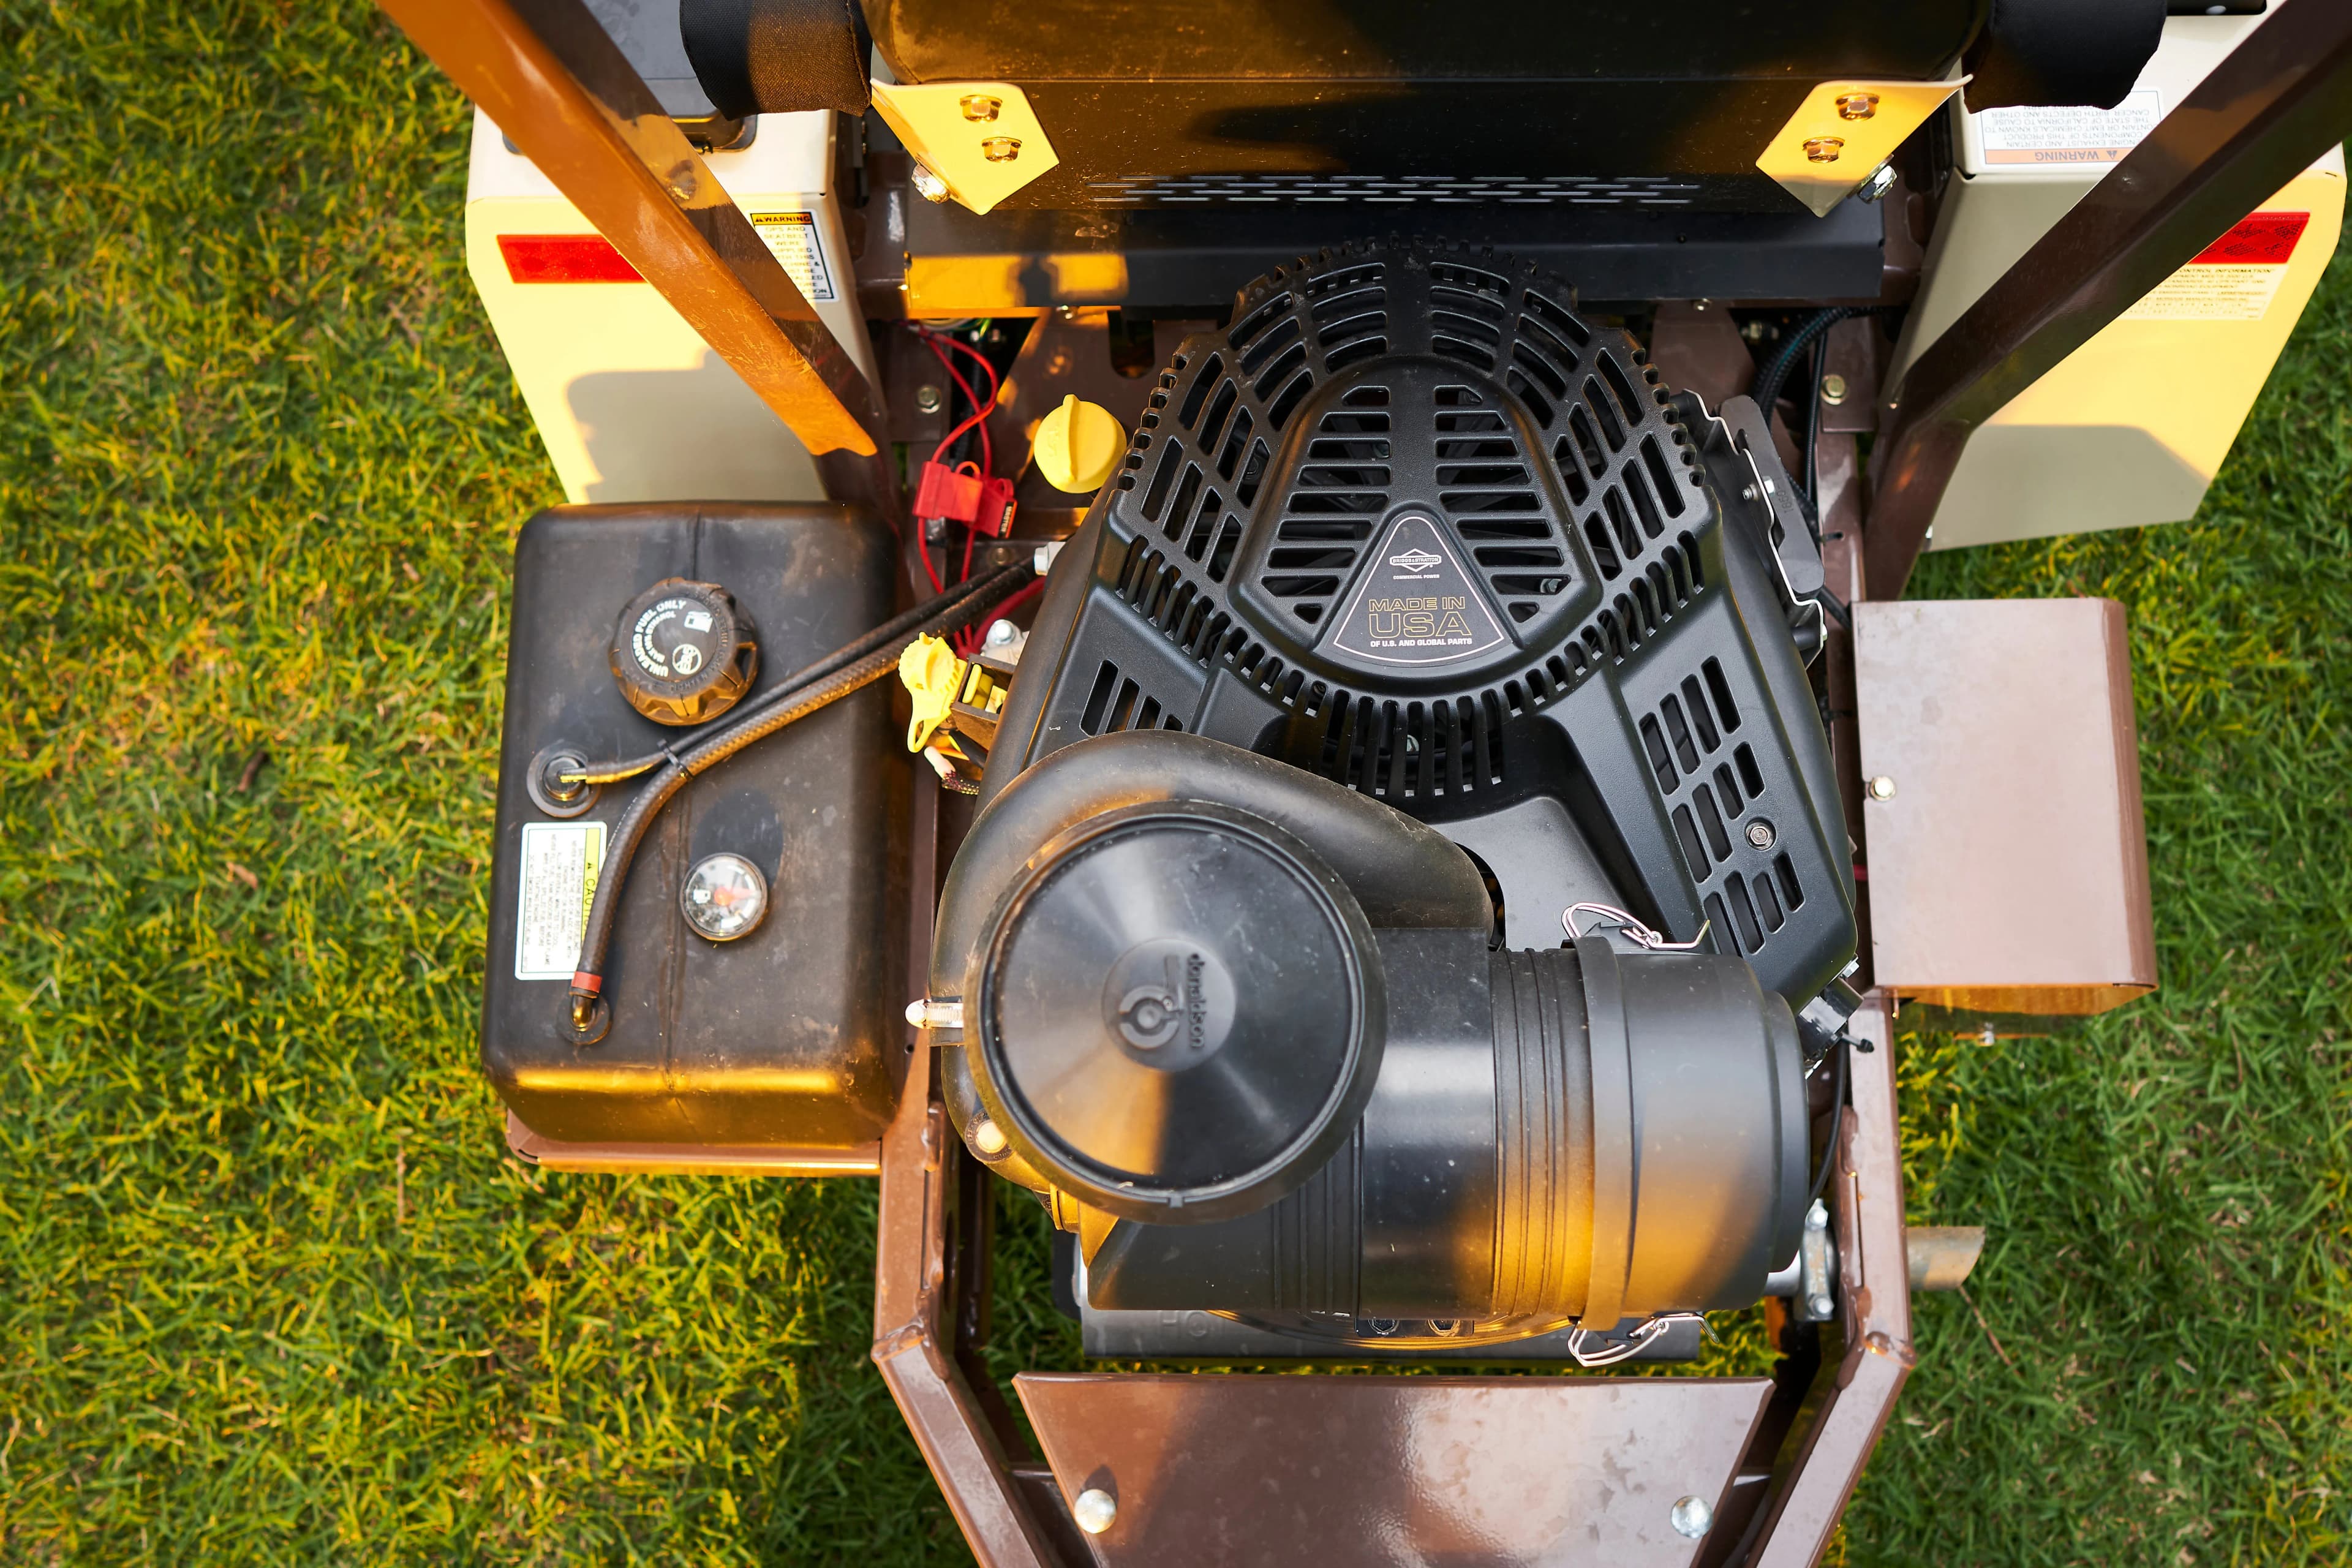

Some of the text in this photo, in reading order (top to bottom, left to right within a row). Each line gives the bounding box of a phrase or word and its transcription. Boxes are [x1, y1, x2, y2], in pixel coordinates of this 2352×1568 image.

[2034, 151, 2100, 161] WARNING
[1369, 597, 1465, 612] MADE IN
[1369, 611, 1472, 638] USA
[633, 600, 687, 677] UNLEADED FUEL ONLY
